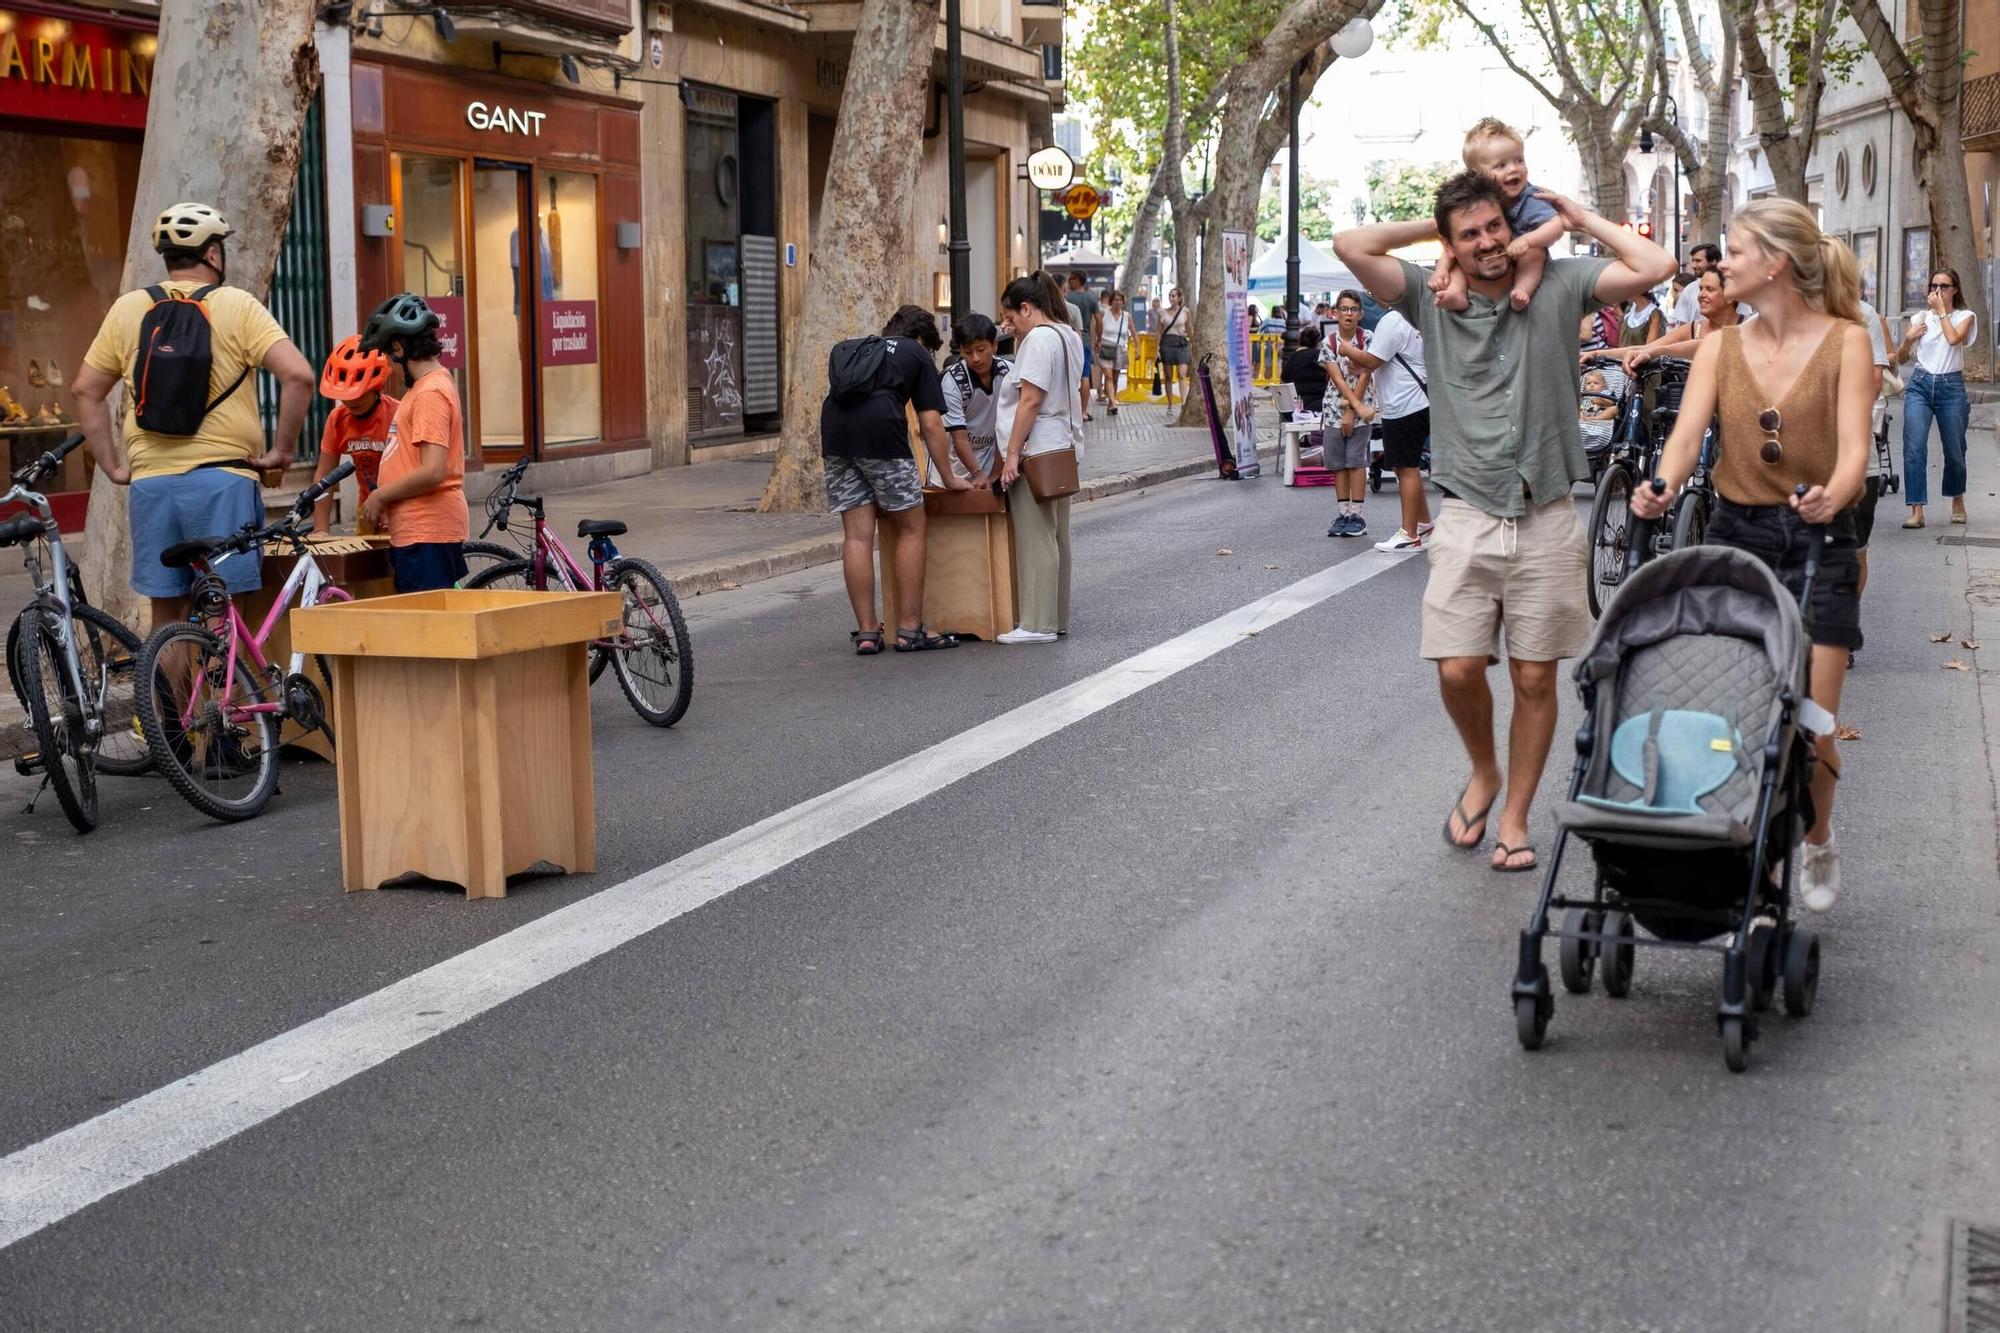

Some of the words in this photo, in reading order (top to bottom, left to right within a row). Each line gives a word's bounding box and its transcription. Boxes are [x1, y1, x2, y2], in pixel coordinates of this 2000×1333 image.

[467, 101, 547, 137] GANT
[552, 337, 562, 357] por
[967, 432, 993, 444] Statio
